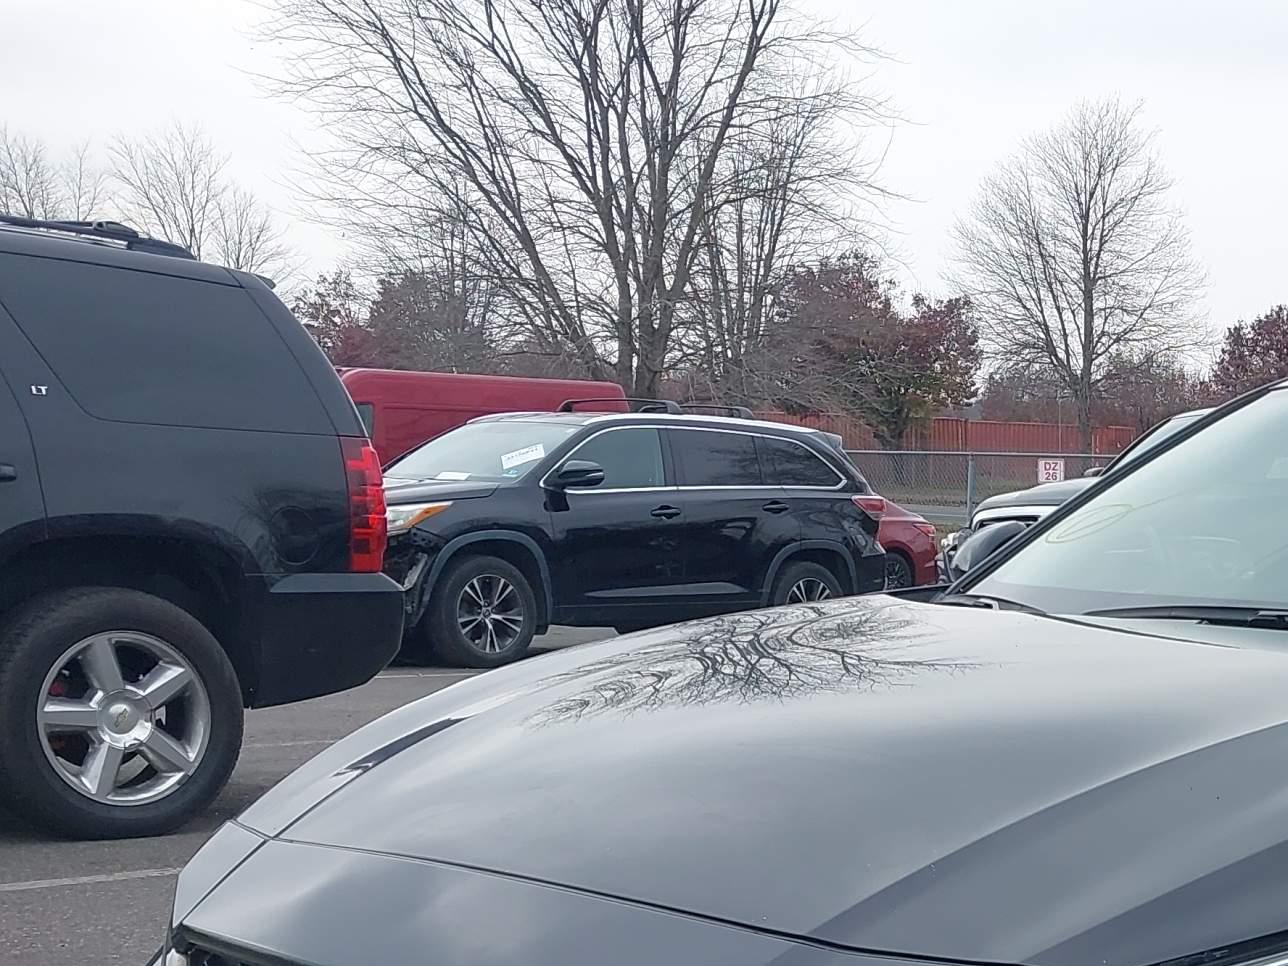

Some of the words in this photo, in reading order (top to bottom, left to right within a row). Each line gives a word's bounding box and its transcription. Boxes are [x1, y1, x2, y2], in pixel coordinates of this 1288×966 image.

[30, 385, 49, 396] LT
[1044, 461, 1059, 471] DZ
[1044, 471, 1058, 481] 26
